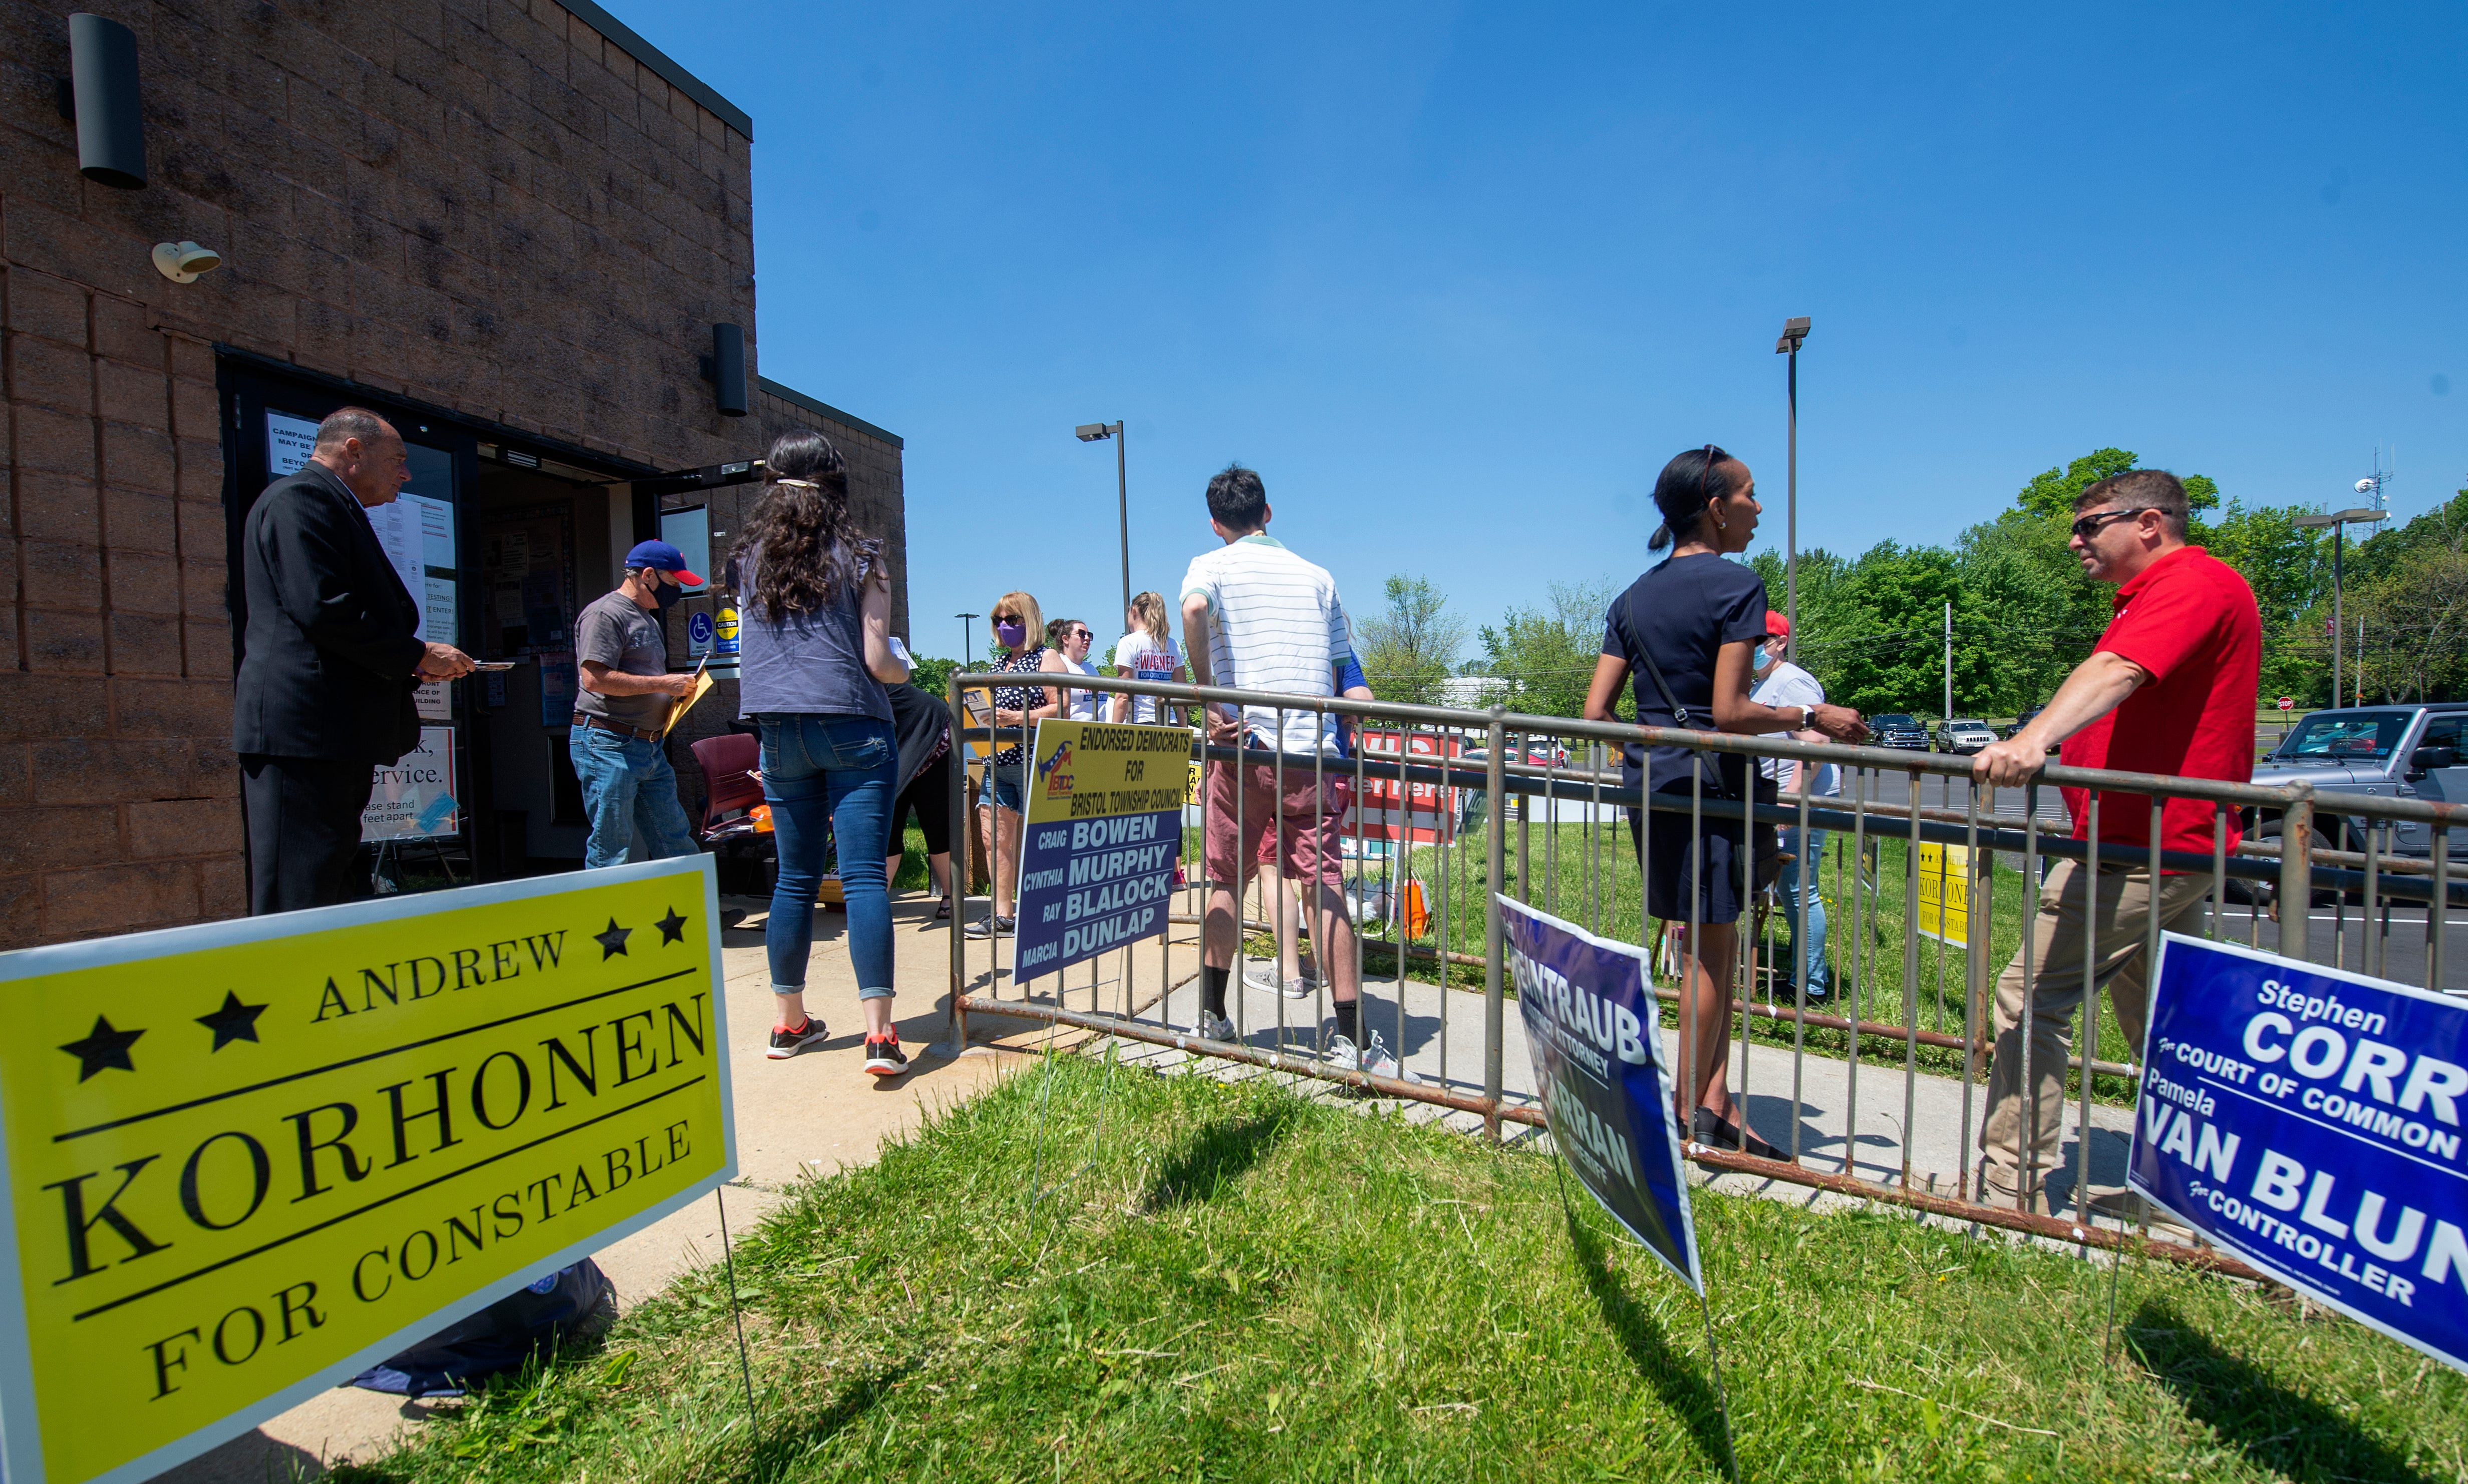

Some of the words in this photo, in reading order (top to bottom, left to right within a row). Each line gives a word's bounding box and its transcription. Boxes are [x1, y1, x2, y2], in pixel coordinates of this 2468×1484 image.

[278, 438, 297, 447] MAY
[428, 593, 453, 602] TESTING?
[1140, 654, 1175, 671] WAGNER
[1079, 726, 1134, 751] ENDORSED
[1136, 728, 1189, 753] DEMOCRATS
[1053, 775, 1074, 790] BTDC
[1125, 759, 1144, 782] FOR
[363, 814, 387, 823] feet
[387, 811, 414, 823] apart
[387, 800, 415, 810] stand
[1070, 792, 1106, 817] BRISTOL
[1109, 790, 1150, 814] TOWNSHIP
[1150, 788, 1181, 809] COUNCIL
[1038, 829, 1067, 851] CRAIG
[1071, 814, 1158, 850] BOWEN
[1024, 867, 1064, 892] CYNTHIA
[1067, 844, 1168, 887] MURPHY
[1935, 854, 1962, 866] ANREW
[1043, 902, 1062, 924] RAY
[1065, 872, 1169, 923] BLALOCK
[1923, 911, 1934, 925] FOR
[1022, 941, 1058, 968] MARCIA
[1062, 907, 1155, 959] DUNLAP
[310, 930, 569, 1024] ANDREW
[2257, 979, 2387, 1036] Stephen
[1556, 1028, 1609, 1080] ATTORNEY
[2242, 1011, 2468, 1126] CORR
[2147, 1067, 2216, 1118] Pamela
[2158, 1037, 2176, 1053] For
[2175, 1043, 2256, 1085] COURT
[2258, 1073, 2300, 1100] OF
[2301, 1087, 2462, 1161] COMMON
[42, 992, 707, 1287] KORHONEN
[1545, 1070, 1637, 1189] ARRAN
[1569, 1133, 1608, 1186] SHERIFF
[2143, 1094, 2242, 1184] VAN
[2251, 1148, 2468, 1296] BLUN
[143, 1281, 327, 1402] FOR
[353, 1120, 691, 1303] CONSTABLE
[2188, 1180, 2210, 1198] For
[2208, 1189, 2416, 1308] CONTROLLER
